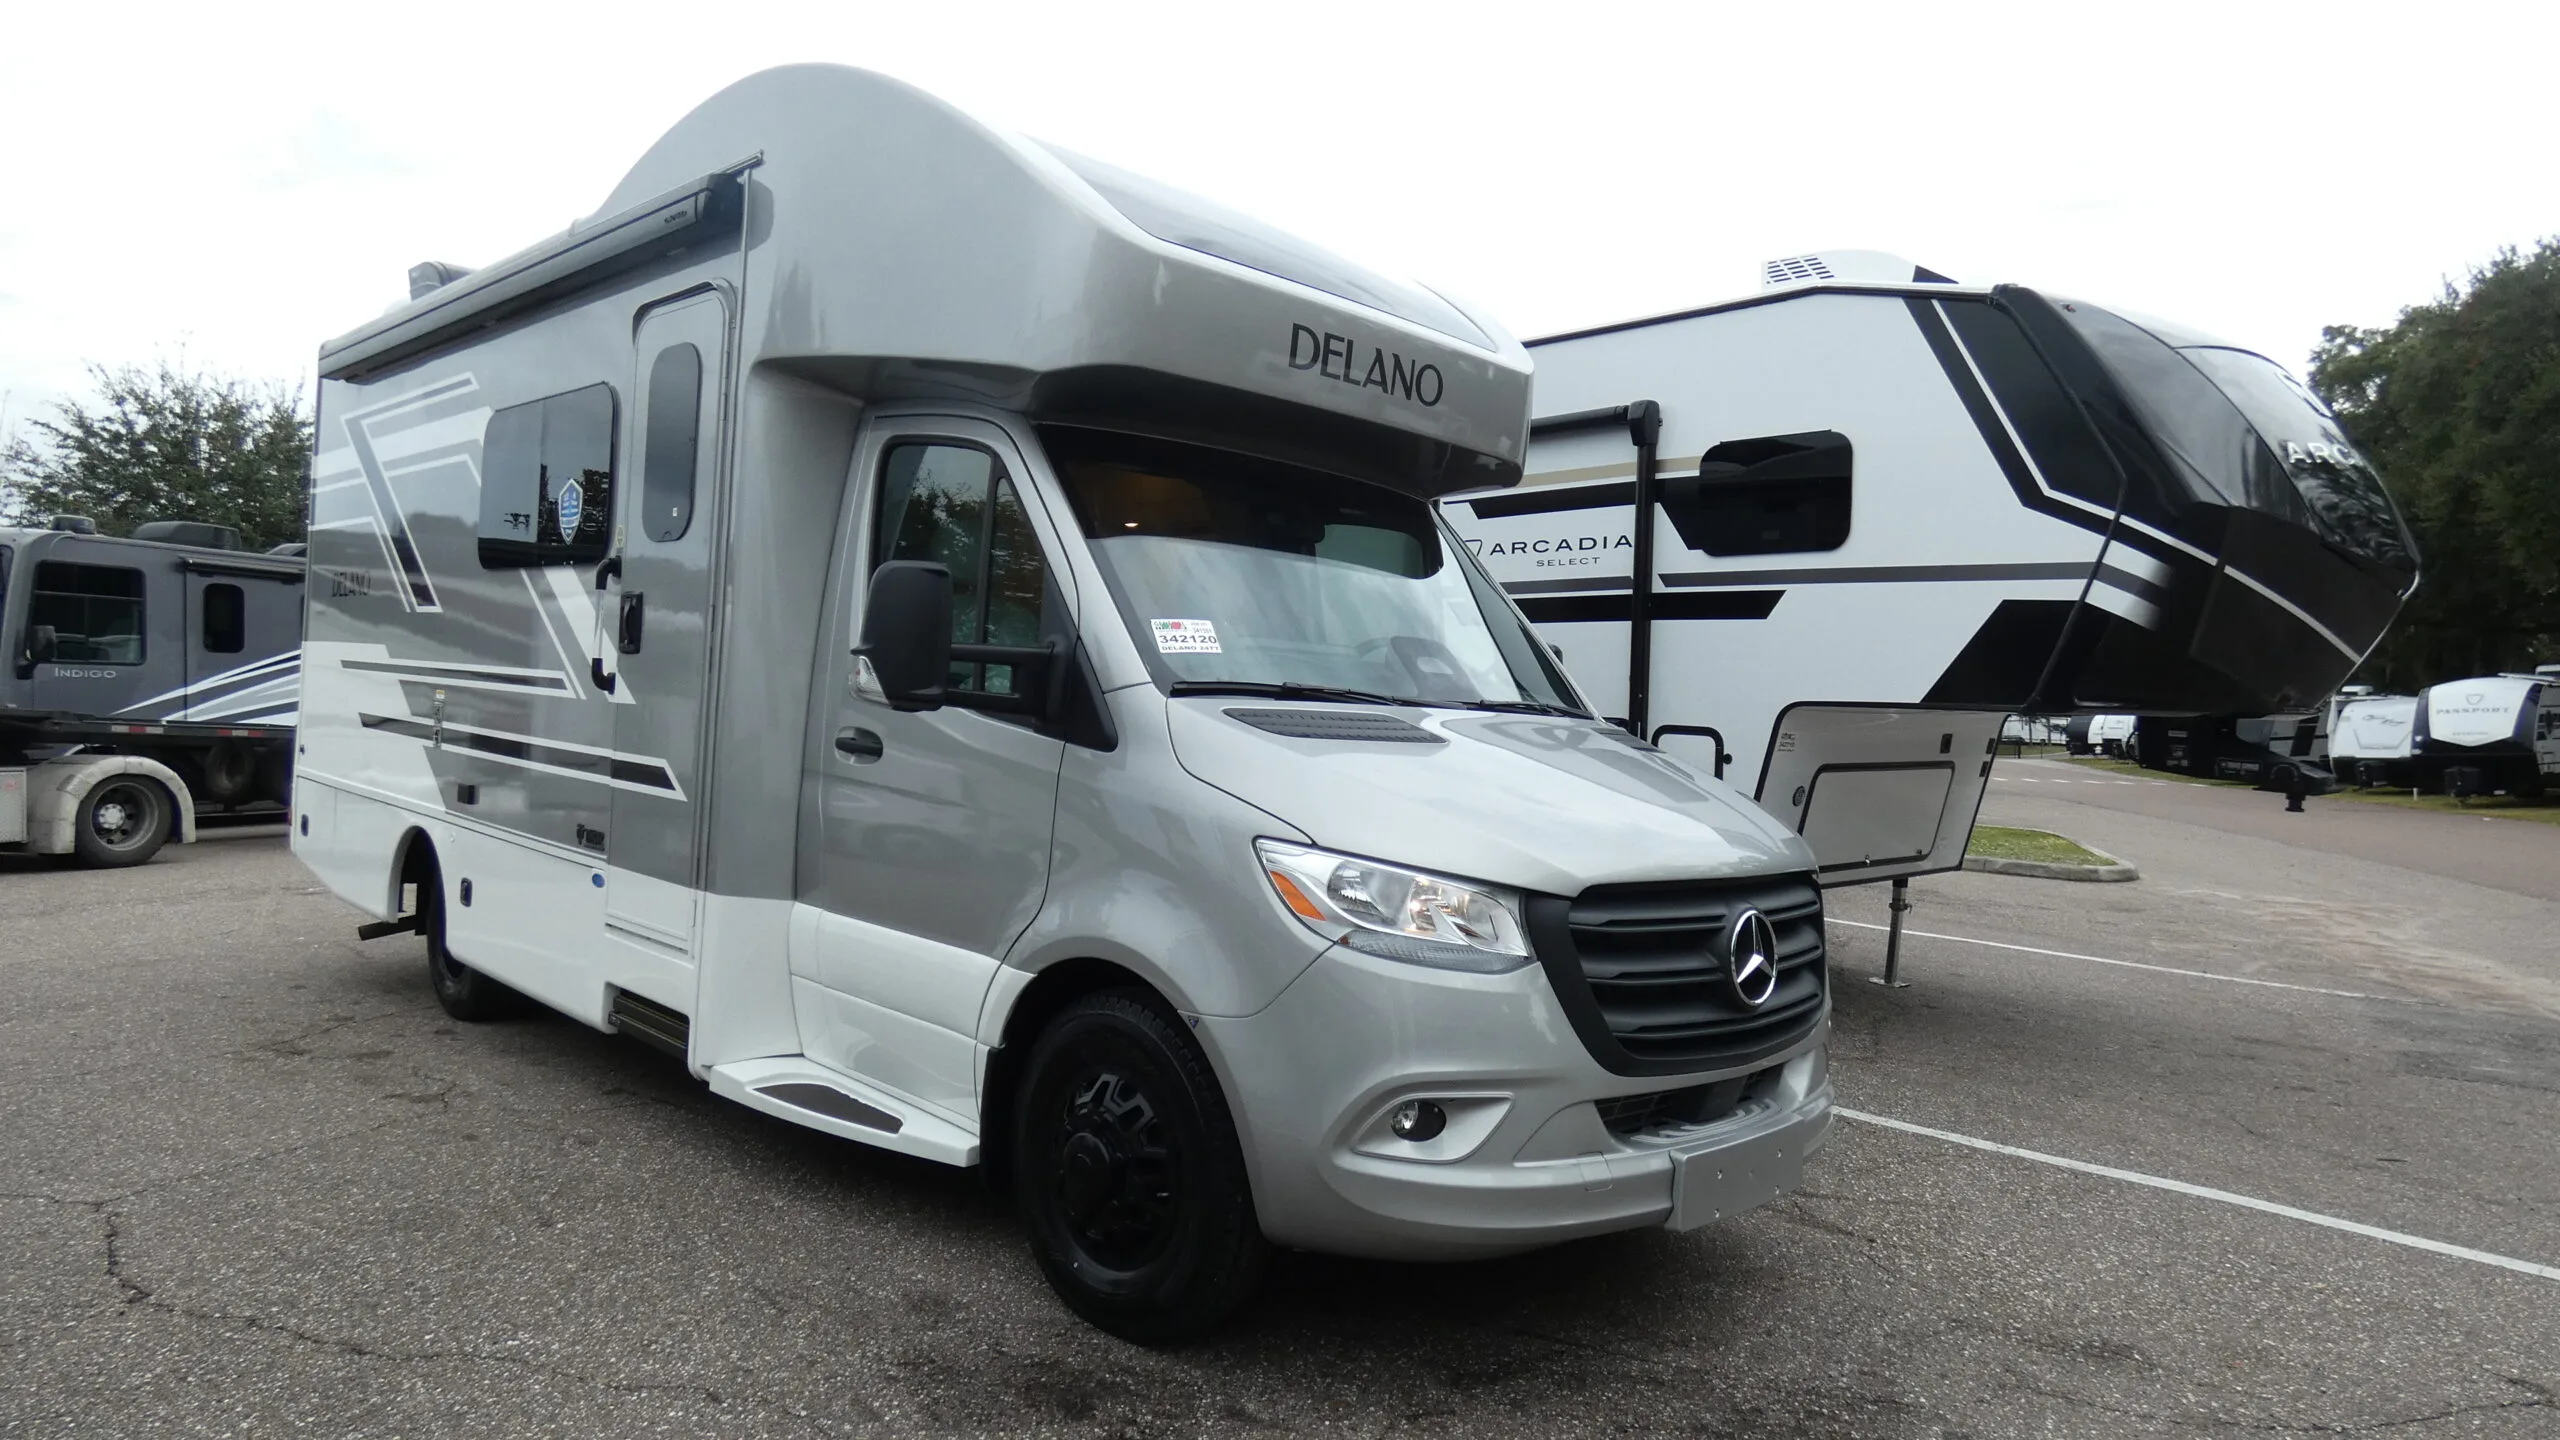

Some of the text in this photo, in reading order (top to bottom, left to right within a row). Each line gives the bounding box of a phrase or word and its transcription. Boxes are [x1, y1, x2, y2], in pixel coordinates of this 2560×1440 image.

[1288, 322, 1444, 407] DELANO
[1489, 534, 1633, 556] ARCADIA
[1535, 556, 1601, 568] SELECT
[331, 571, 371, 598] DELANO
[1159, 634, 1217, 644] 342120
[54, 667, 117, 679] INDIGO
